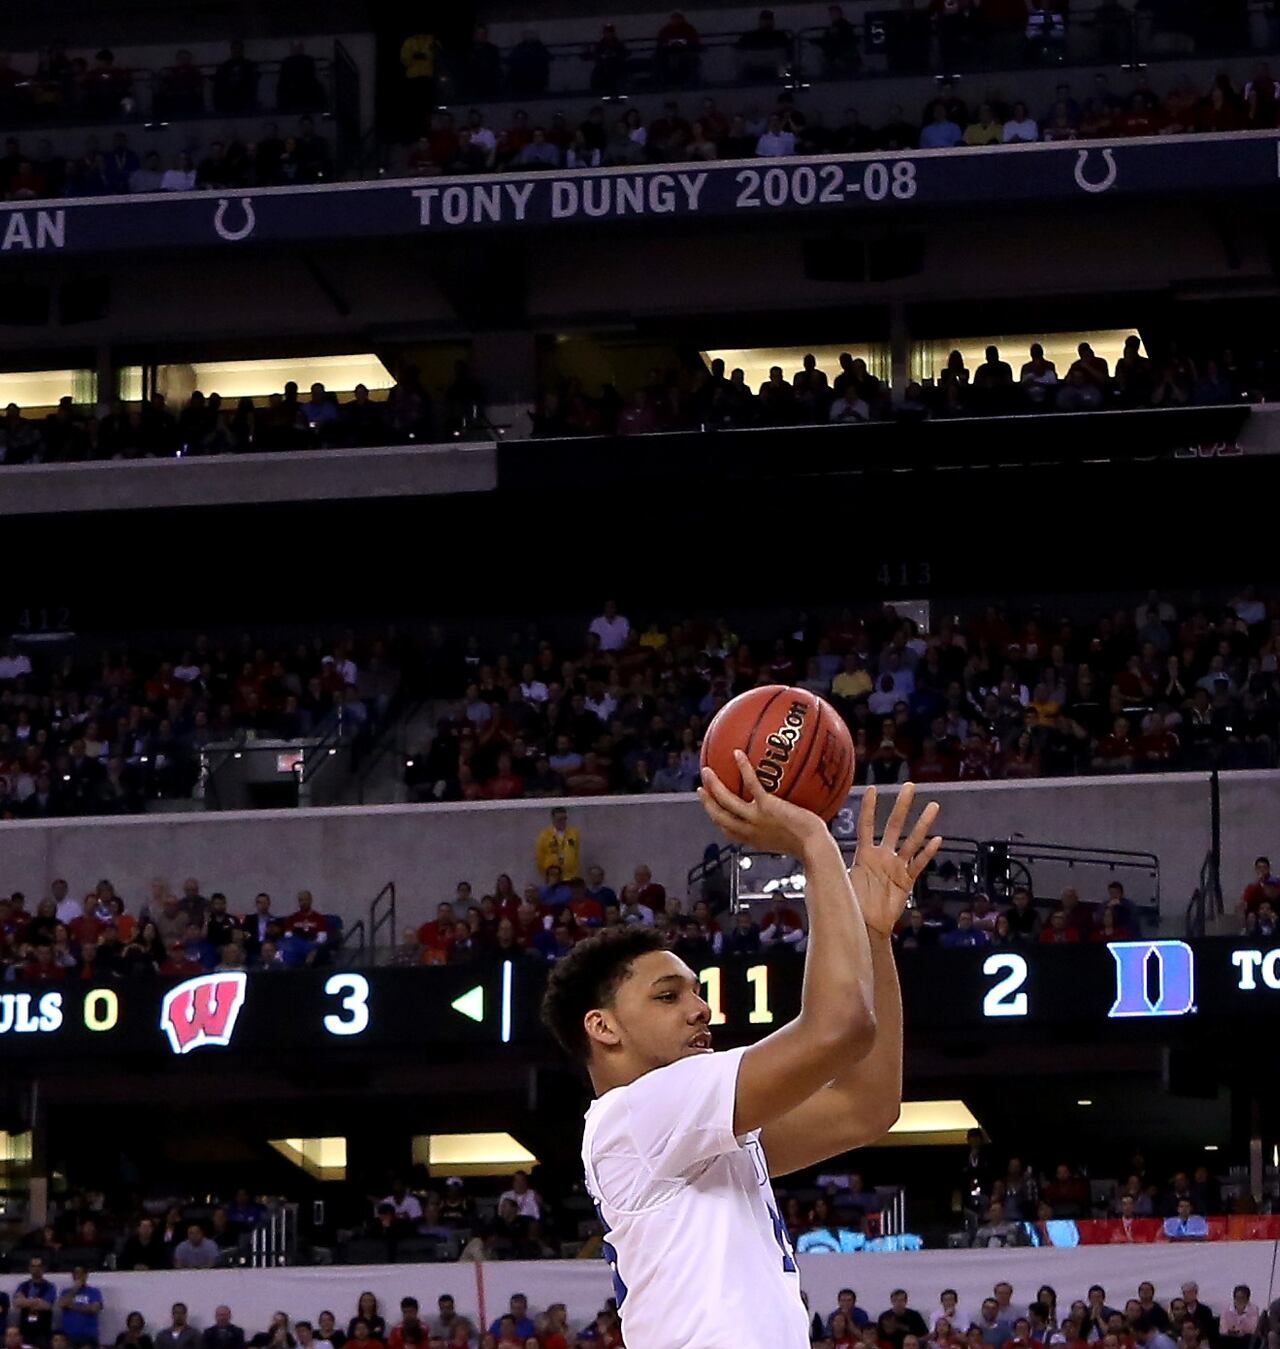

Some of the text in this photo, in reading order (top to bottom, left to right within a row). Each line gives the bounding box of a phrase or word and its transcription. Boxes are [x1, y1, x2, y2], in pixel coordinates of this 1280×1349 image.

[411, 161, 918, 225] TONY DUNGY 2002-08
[83, 989, 118, 1032] 0
[324, 973, 370, 1035] 3
[983, 953, 1028, 1016] 2
